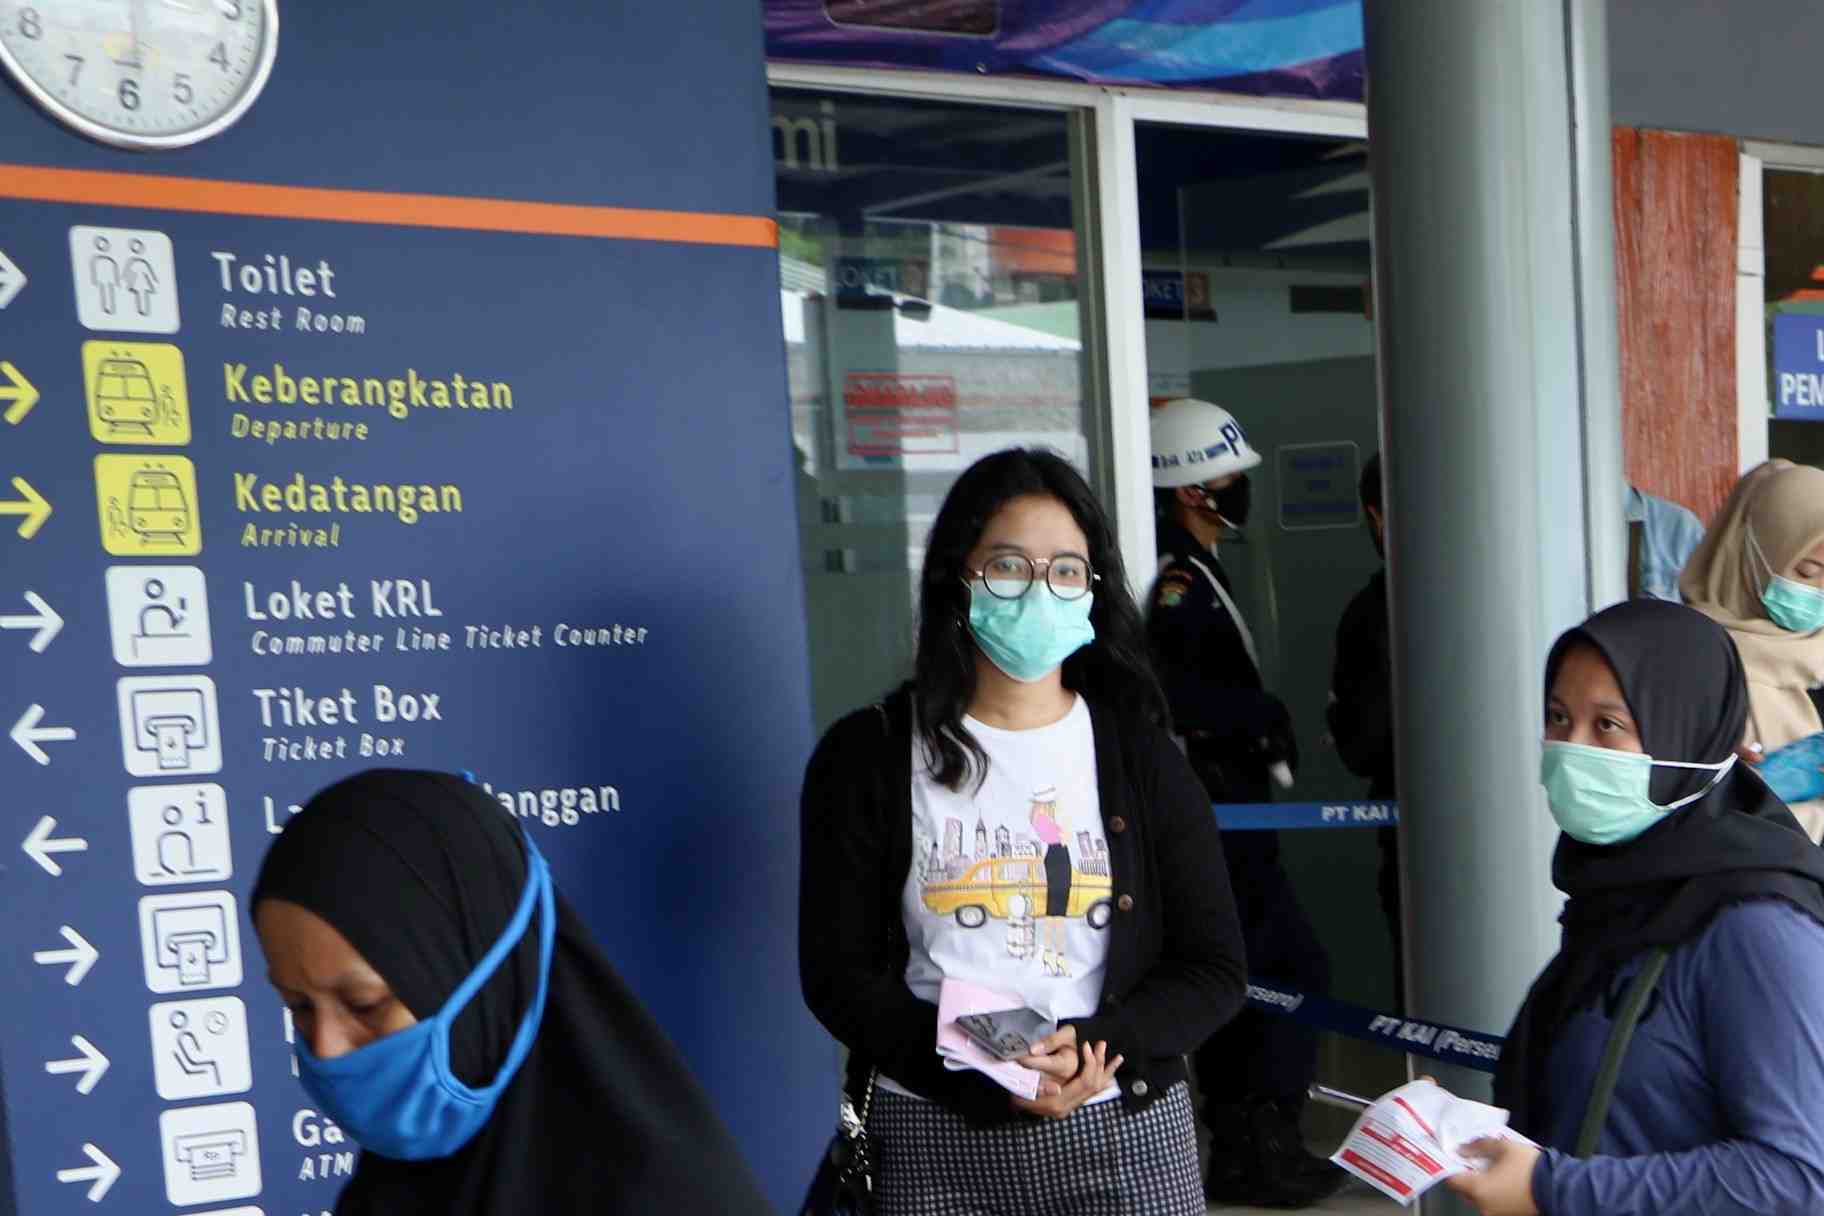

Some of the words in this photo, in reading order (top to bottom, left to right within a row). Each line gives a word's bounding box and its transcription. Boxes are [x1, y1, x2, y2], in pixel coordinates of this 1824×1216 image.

[18, 7, 43, 40] 8
[63, 52, 85, 86] 7
[208, 41, 231, 72] 4
[117, 78, 142, 111] 6
[172, 73, 194, 105] 5
[211, 251, 336, 298] Toilet
[220, 302, 283, 331] Rest
[296, 306, 366, 334] Room
[224, 362, 513, 419] Keberangkatan
[230, 413, 369, 445] Departure
[234, 472, 463, 525] Kedatangan
[241, 522, 341, 548] Arrival
[244, 579, 355, 621] Loket
[371, 578, 443, 618] KRL
[251, 628, 384, 656] Commuter
[396, 627, 451, 652] Line
[464, 624, 543, 649] Ticket
[554, 622, 648, 648] Counter
[252, 687, 358, 728] Tiket
[373, 684, 443, 723] Box
[262, 735, 348, 762] Ticket
[359, 733, 406, 759] Box
[494, 783, 621, 828] anggan
[1321, 805, 1350, 822] PT
[1353, 804, 1389, 821] KAI
[1368, 1014, 1401, 1037] PT
[1396, 1022, 1438, 1047] KAI
[1433, 1028, 1500, 1061] (Perse
[298, 1151, 354, 1182] ATM
